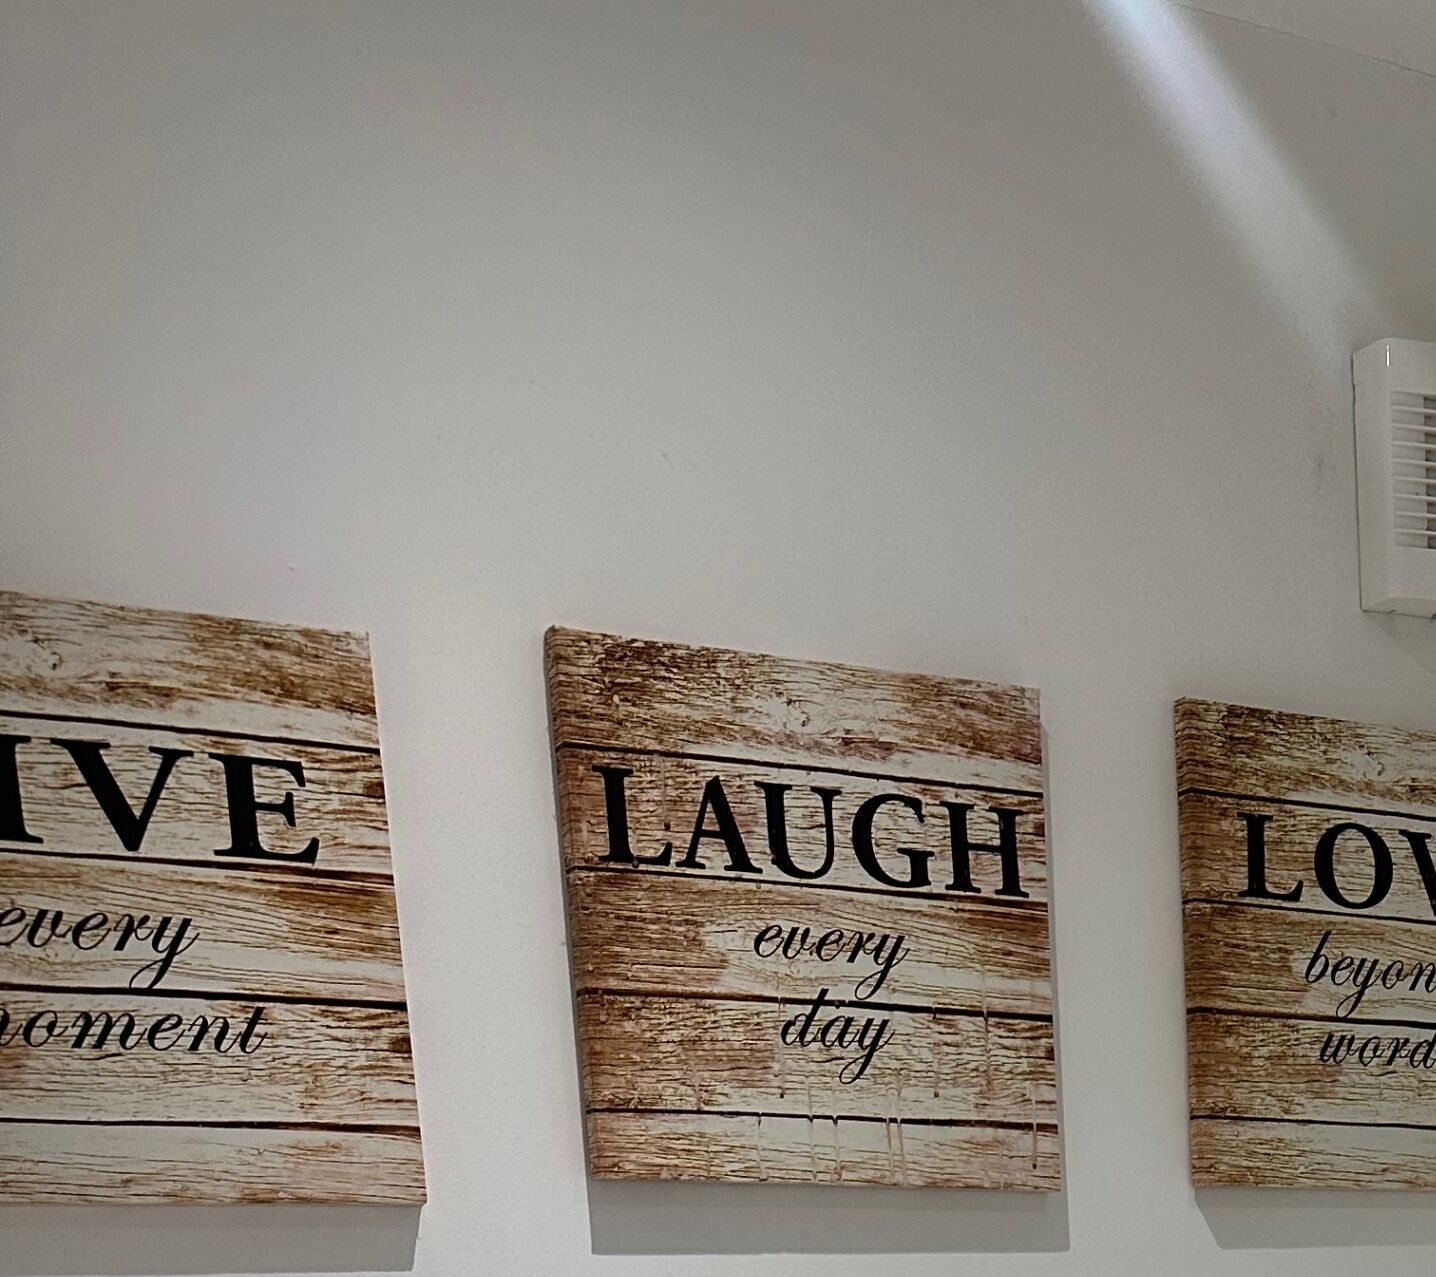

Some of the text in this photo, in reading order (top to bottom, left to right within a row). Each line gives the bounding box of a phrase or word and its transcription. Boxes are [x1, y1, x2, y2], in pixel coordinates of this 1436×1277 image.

[592, 766, 1030, 898] LAUGH
[0, 907, 200, 990] every
[754, 923, 910, 1000] every
[780, 988, 895, 1083] day
